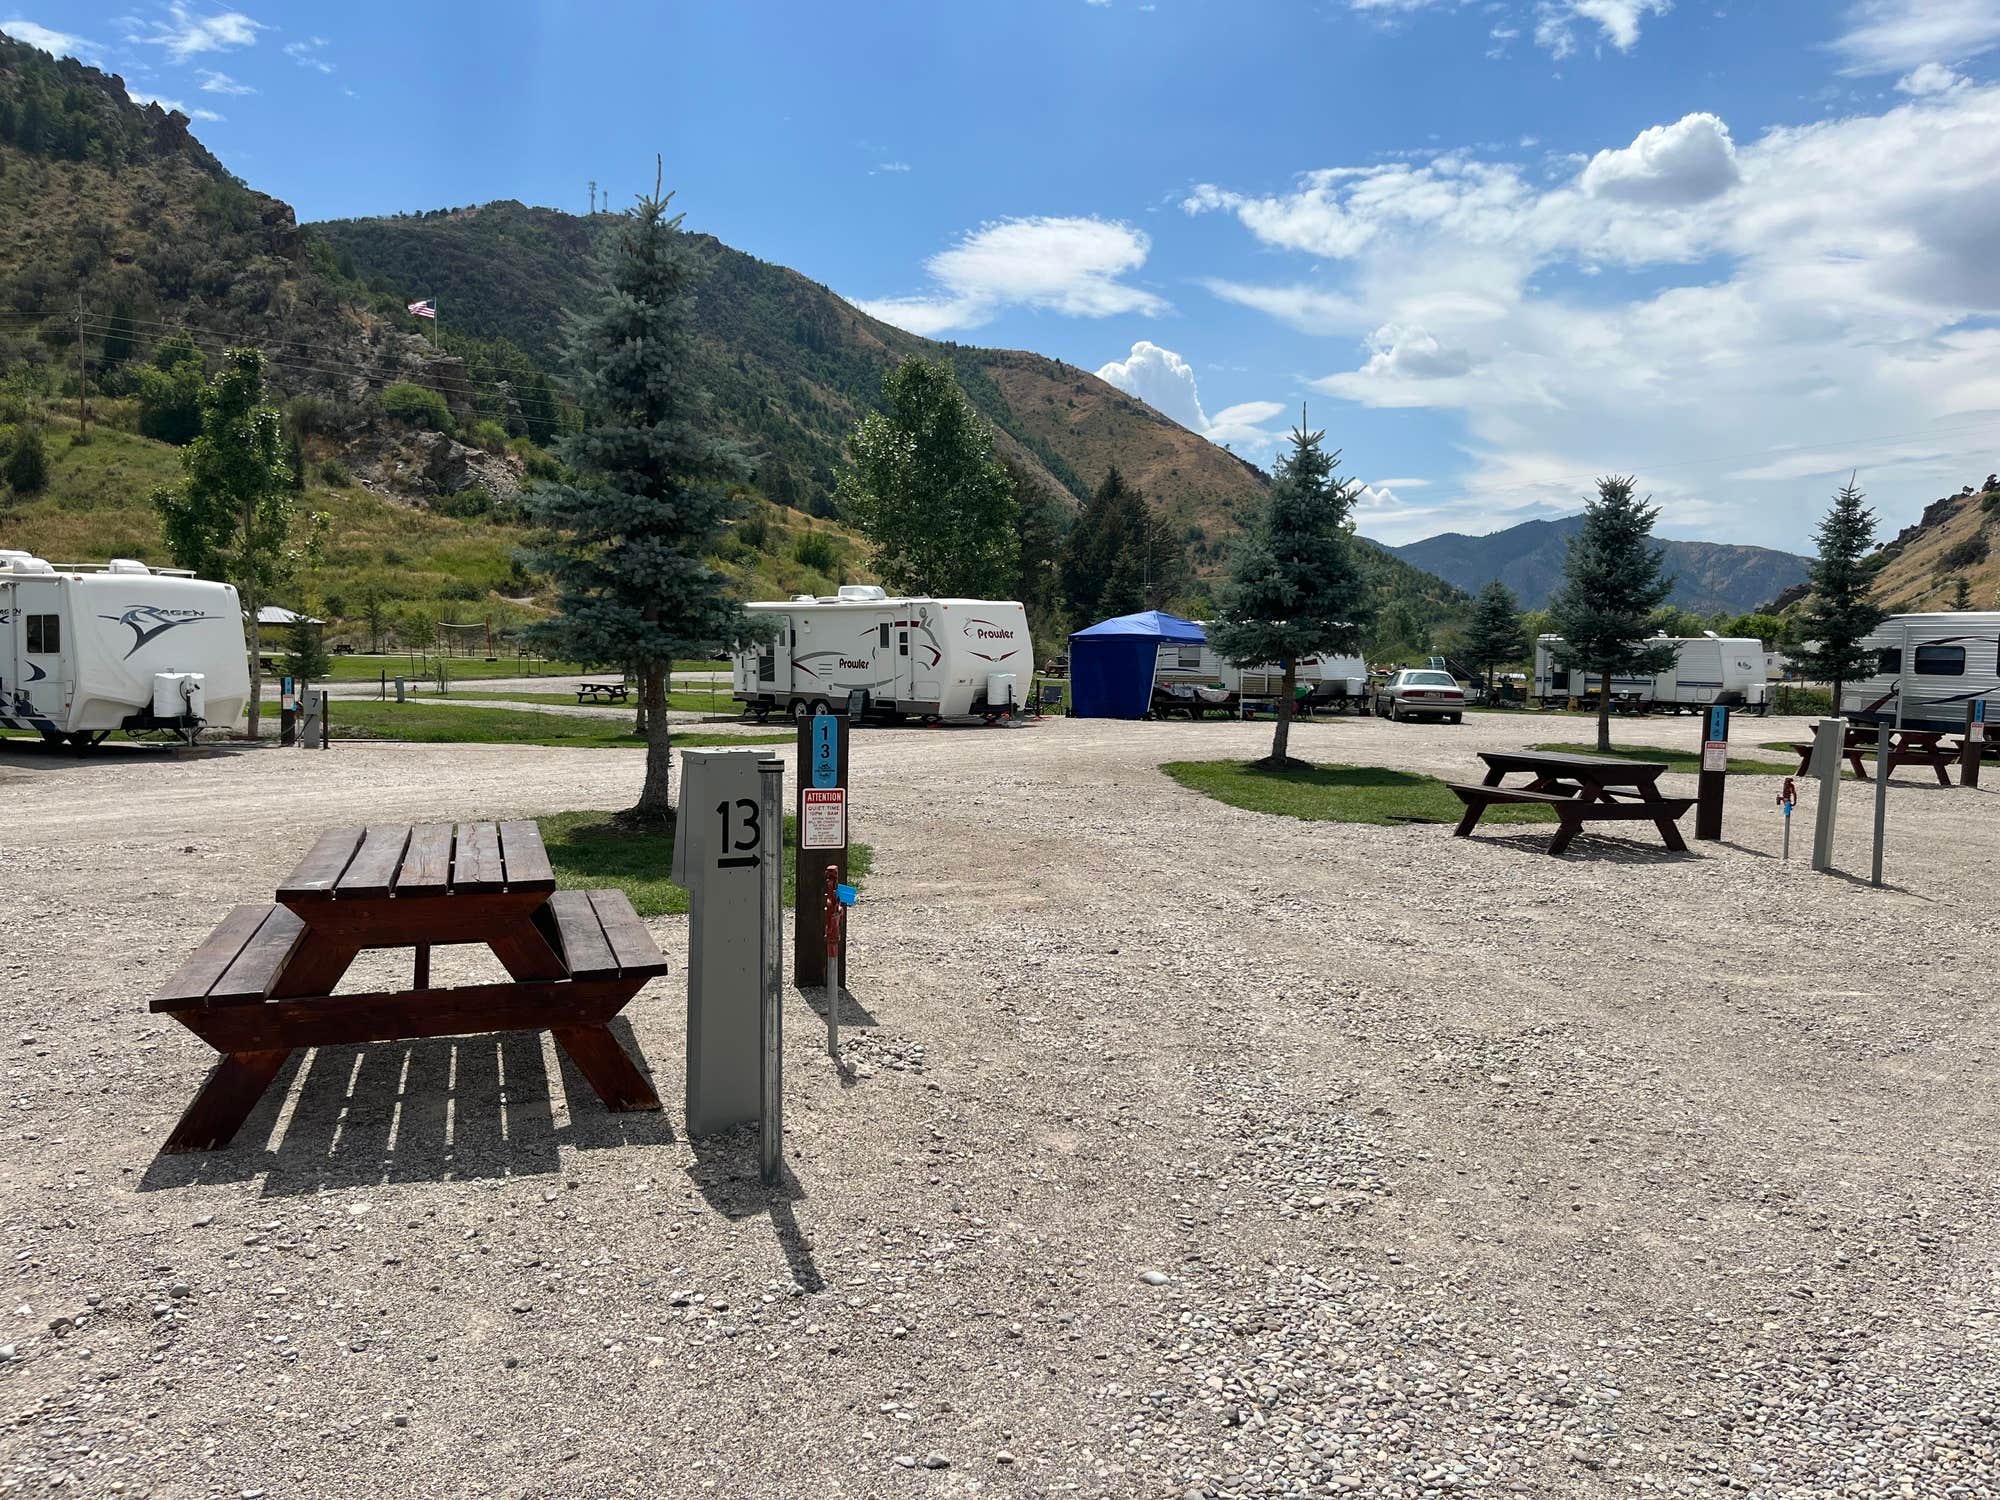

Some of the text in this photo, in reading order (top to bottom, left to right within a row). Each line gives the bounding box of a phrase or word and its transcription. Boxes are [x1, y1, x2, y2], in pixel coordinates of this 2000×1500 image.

[977, 628, 1014, 639] Prowler
[839, 658, 870, 670] Prowler
[807, 792, 842, 801] ATTENTION
[716, 799, 760, 854] 13
